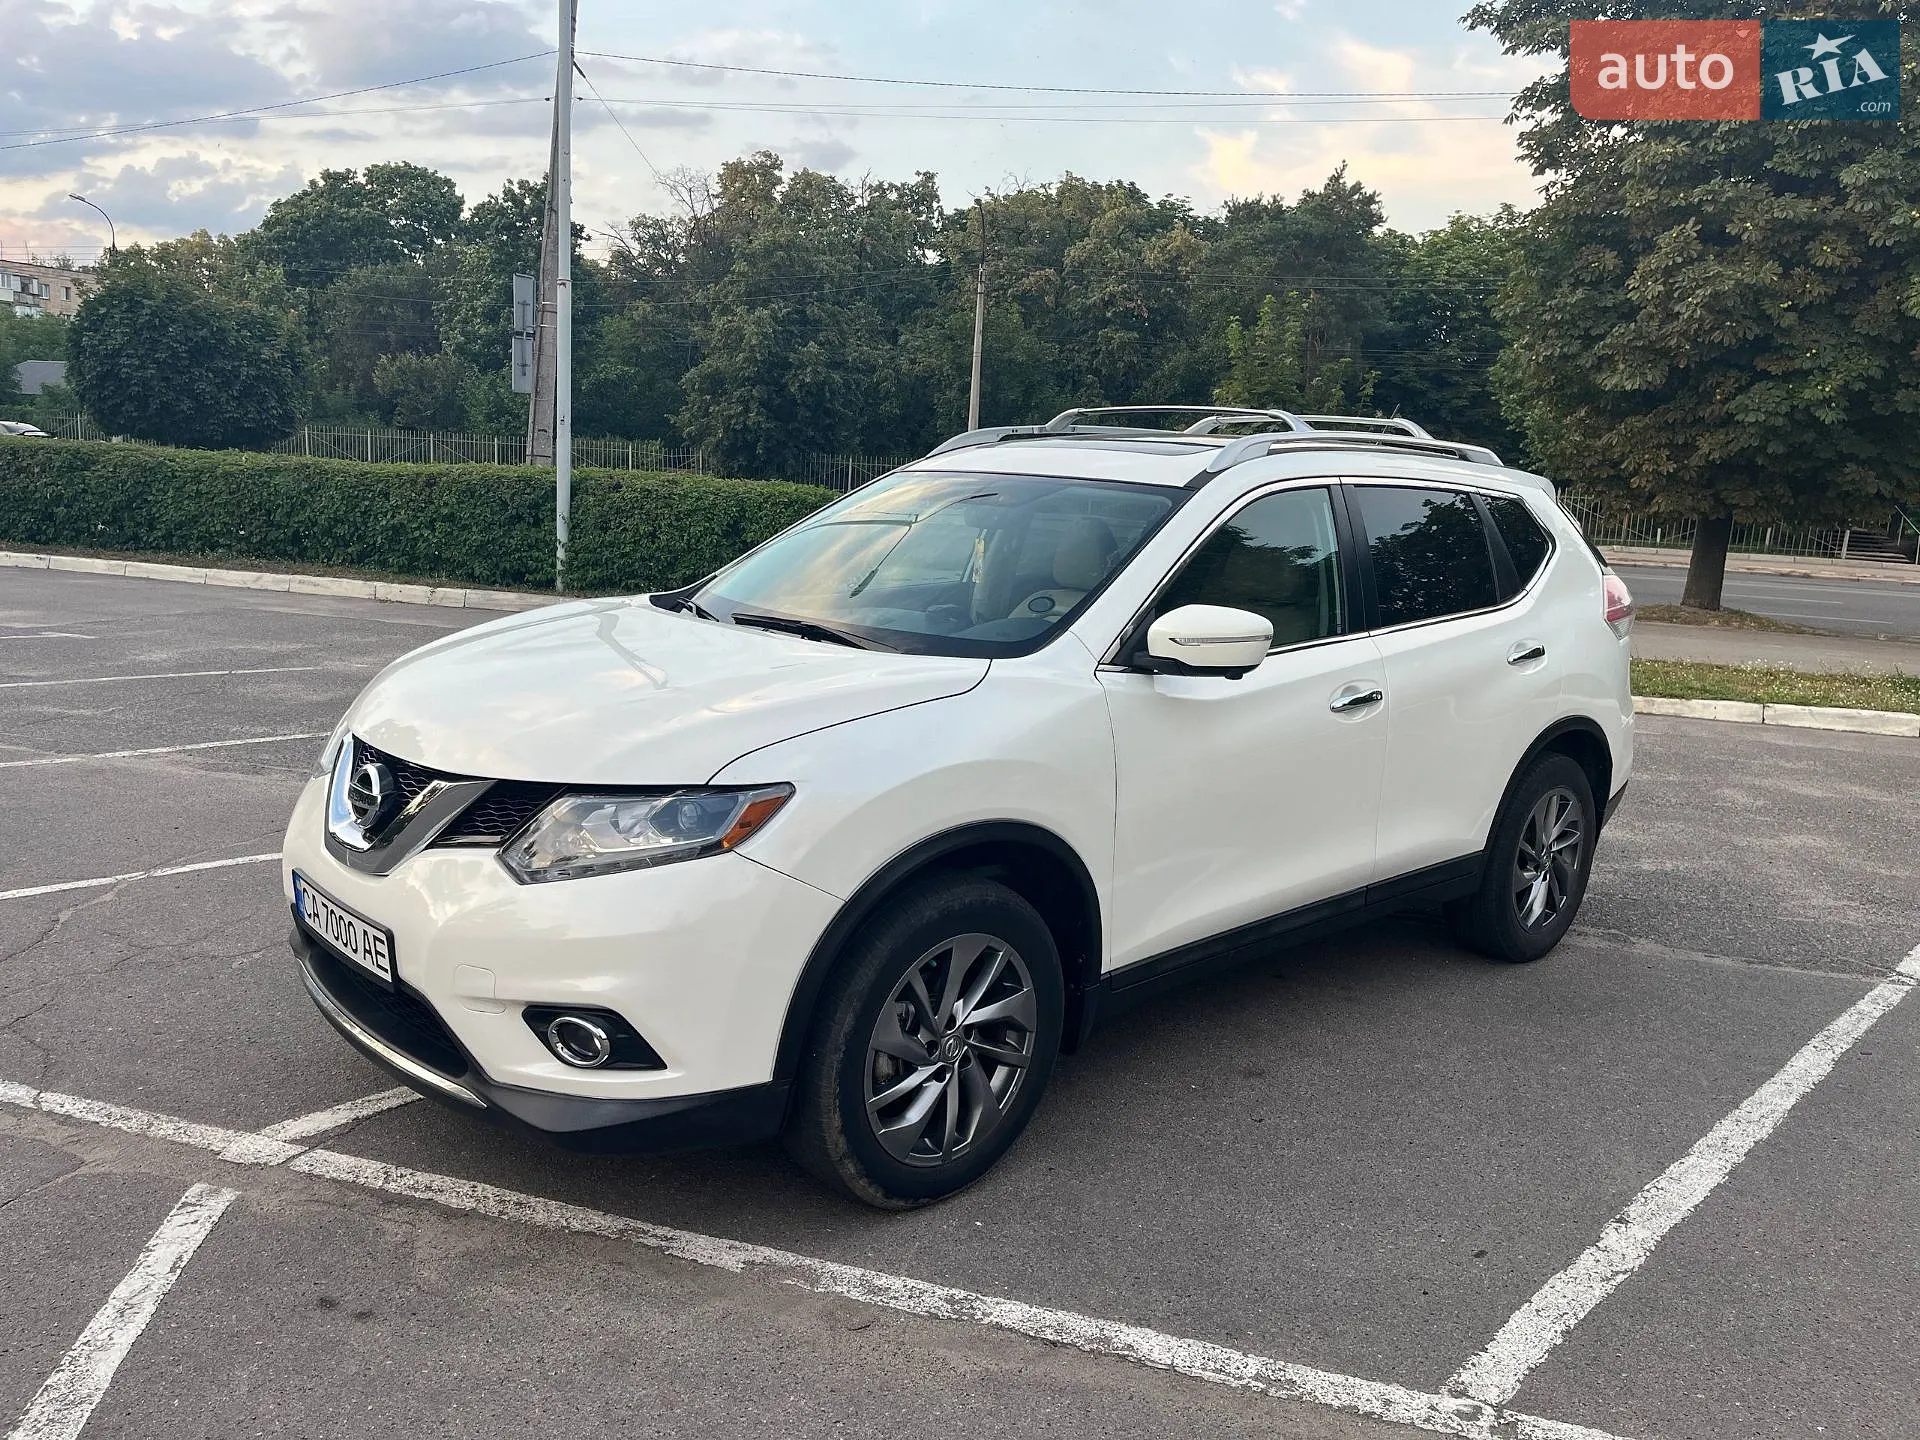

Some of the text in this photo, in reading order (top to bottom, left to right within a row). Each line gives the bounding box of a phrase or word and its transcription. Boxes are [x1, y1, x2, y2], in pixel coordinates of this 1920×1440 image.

[302, 887, 322, 929] CA
[321, 900, 358, 954] 7000
[362, 928, 389, 974] AE
